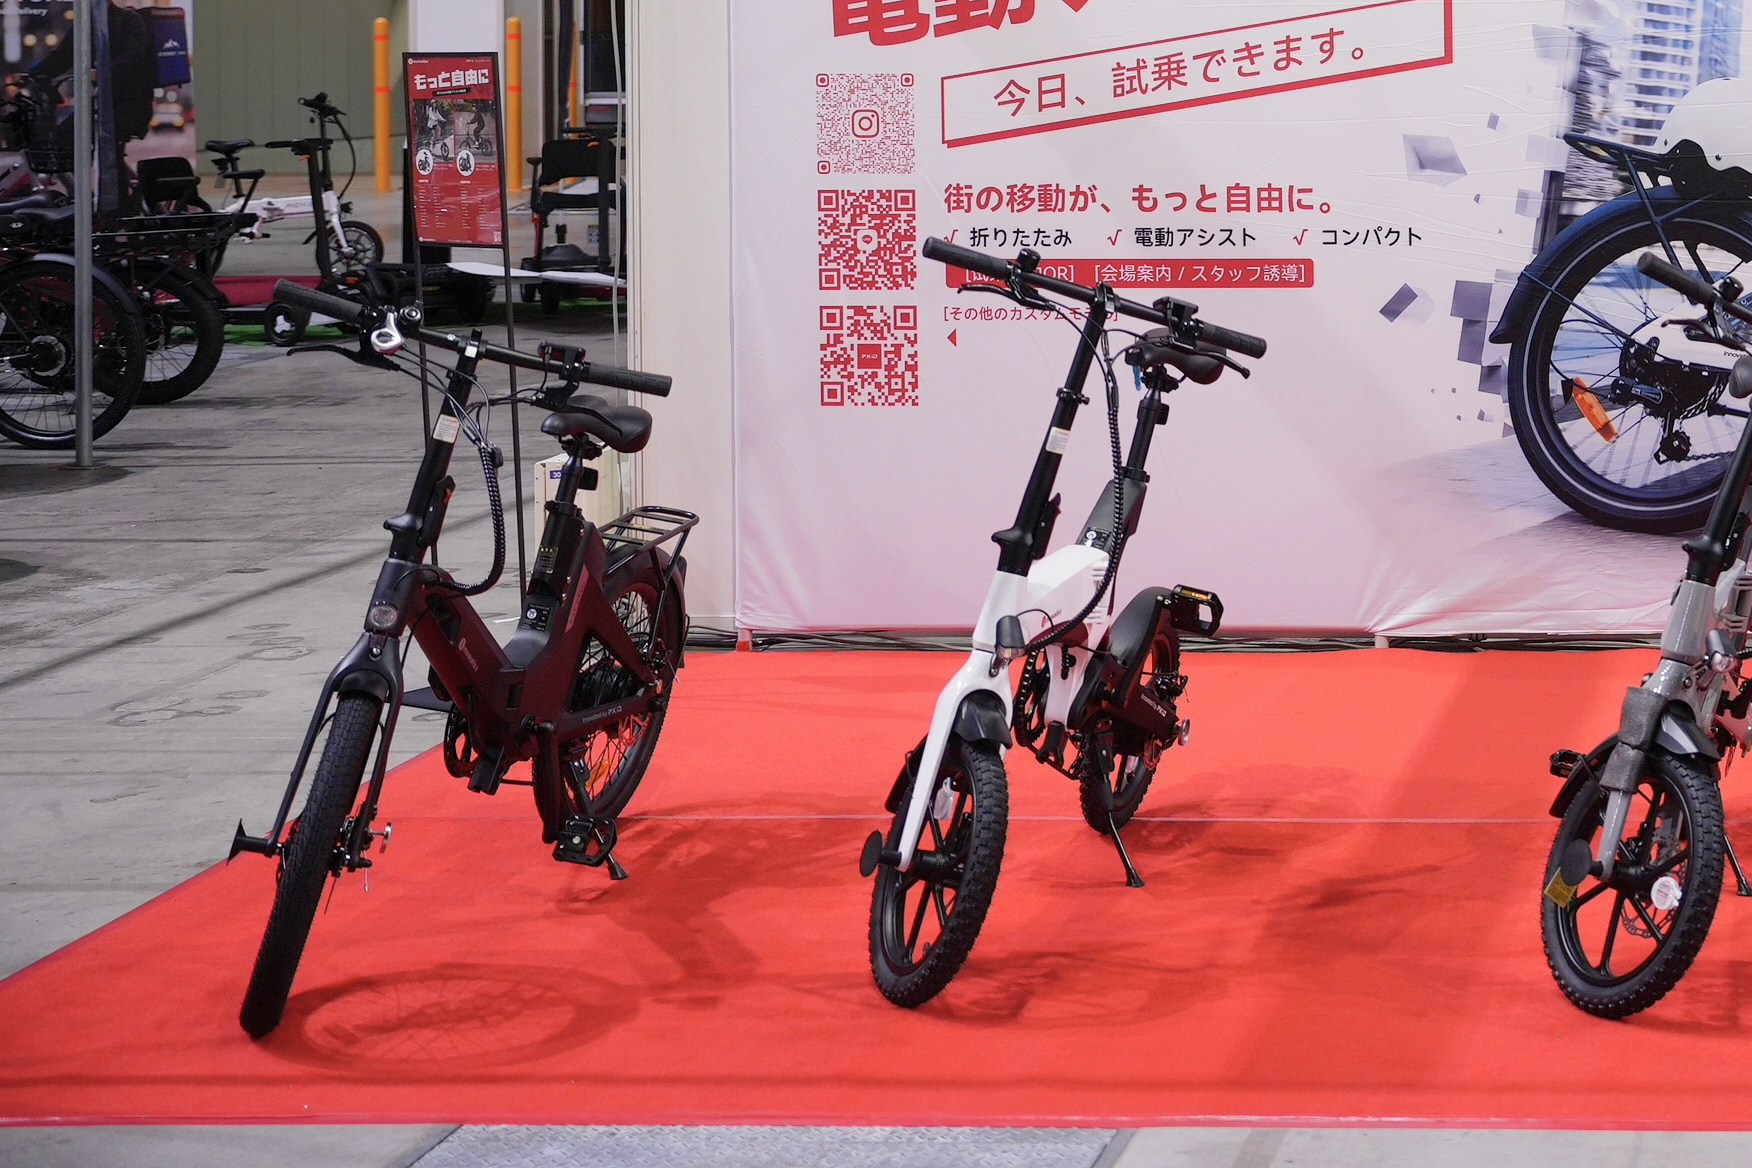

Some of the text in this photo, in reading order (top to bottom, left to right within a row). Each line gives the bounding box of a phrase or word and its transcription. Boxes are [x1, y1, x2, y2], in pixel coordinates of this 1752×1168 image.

[414, 69, 490, 90] もっと自由に
[994, 28, 1366, 117] 今日、試乗できます。
[944, 183, 1334, 215] 街の移動が、もっと自由に。
[971, 226, 1423, 248] 折りたたみ 電動アシスト コンパクト
[1095, 264, 1171, 284] [会場案内
[1191, 264, 1305, 283] スタッフ誘導]
[943, 306, 1118, 322] [その他のカスタムモ]
